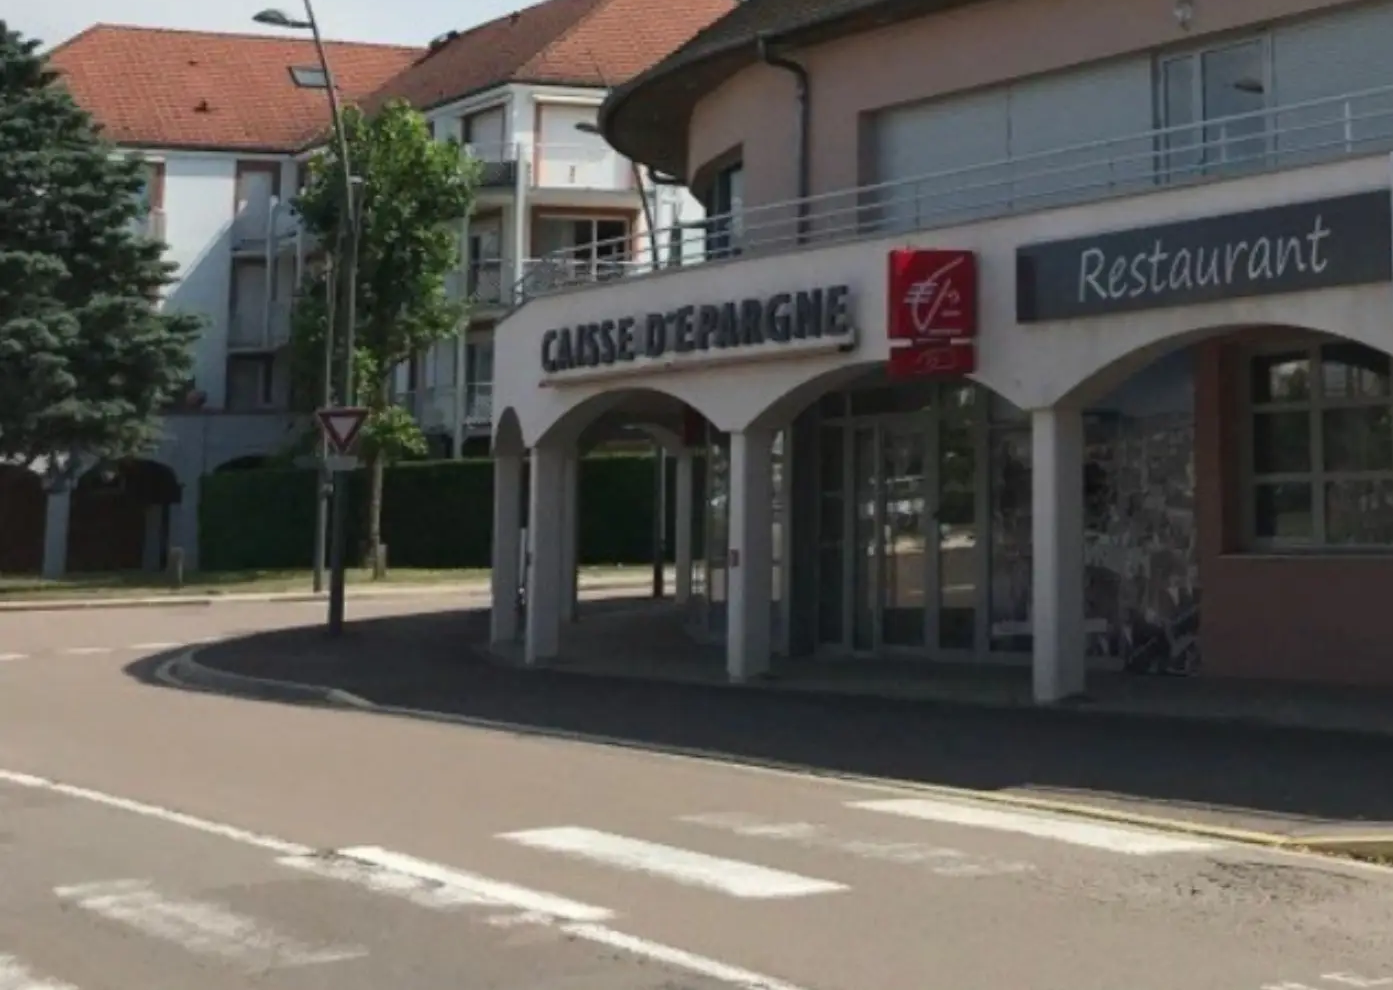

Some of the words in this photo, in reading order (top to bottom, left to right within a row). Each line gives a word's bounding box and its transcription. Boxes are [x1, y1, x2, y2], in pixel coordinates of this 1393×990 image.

[1077, 213, 1332, 303] Restaurant
[541, 316, 636, 373] CAISSE
[644, 284, 850, 358] D'EPARGNE
